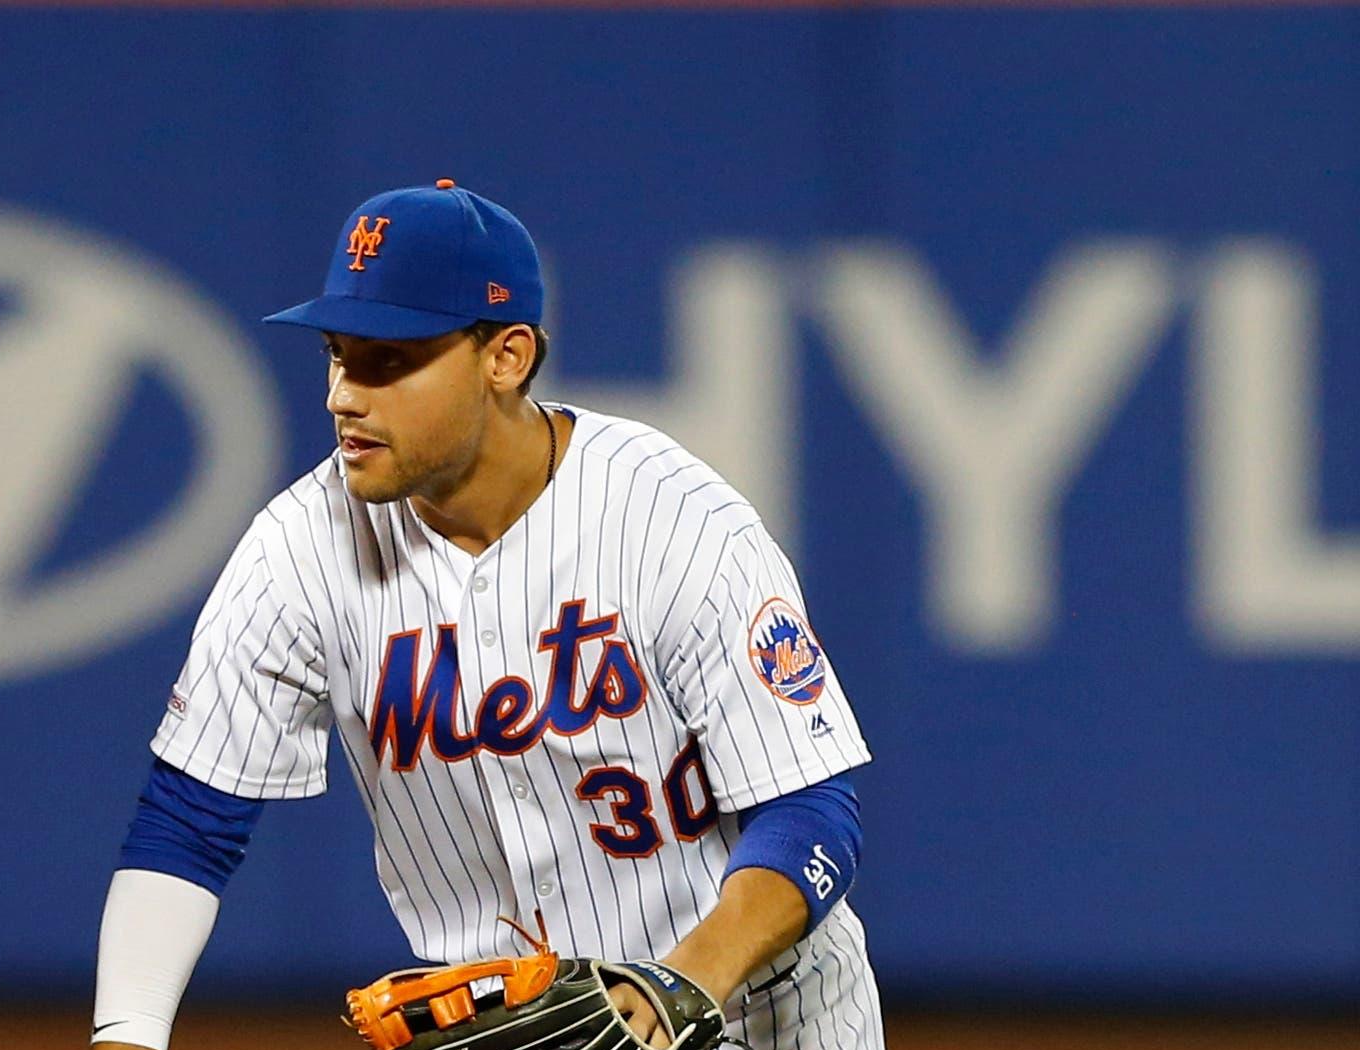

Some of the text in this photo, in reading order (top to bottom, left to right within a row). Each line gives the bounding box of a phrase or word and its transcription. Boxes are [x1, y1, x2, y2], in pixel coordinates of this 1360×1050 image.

[369, 598, 648, 772] Mets
[771, 634, 815, 684] Mets
[574, 732, 724, 859] 30
[803, 858, 834, 900] 30
